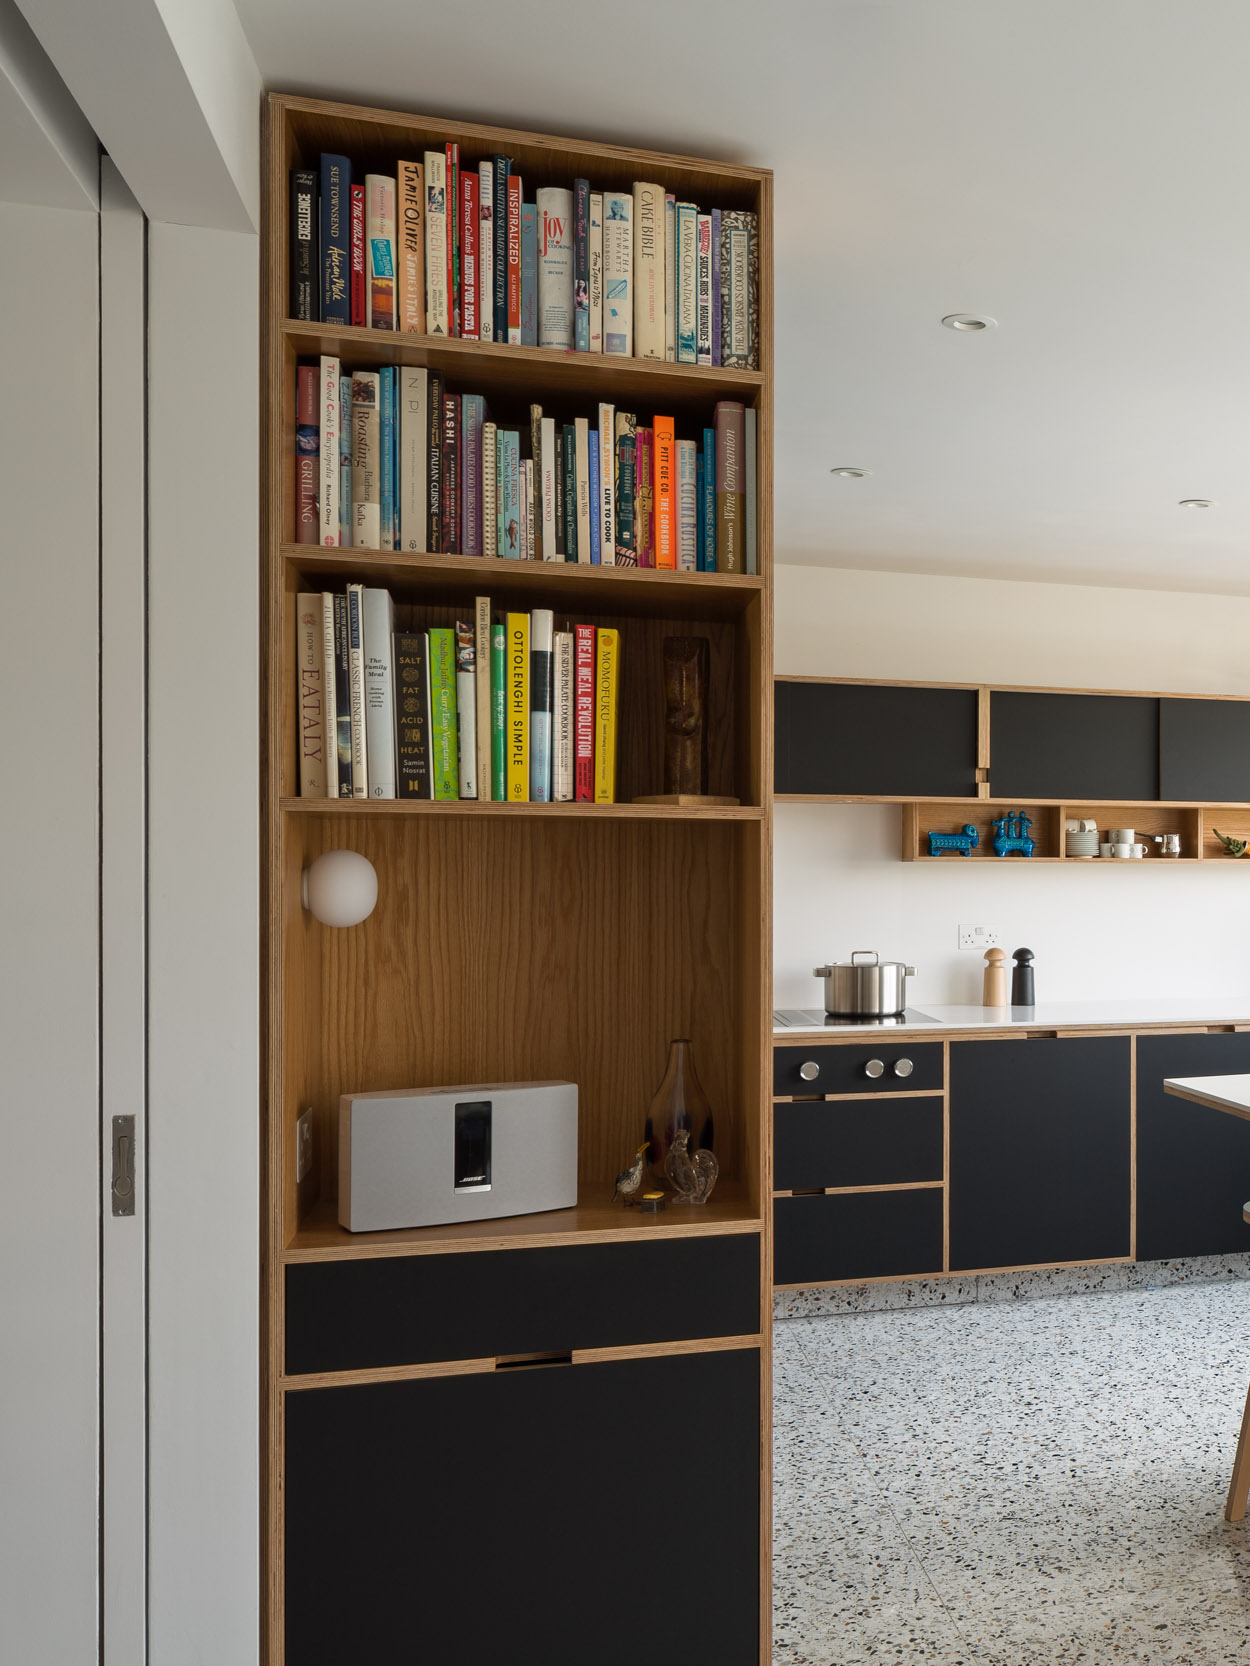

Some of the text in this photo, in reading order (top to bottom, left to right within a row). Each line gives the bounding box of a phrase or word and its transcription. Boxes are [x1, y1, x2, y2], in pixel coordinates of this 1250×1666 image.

[330, 166, 339, 237] SUE TOWNSEND
[353, 201, 362, 218] THE
[353, 219, 362, 248] GIRLS'
[496, 159, 505, 307] DELIA SMITH'S SUMMER COLLECTION
[538, 211, 568, 257] joy
[578, 218, 587, 238] Food
[641, 190, 654, 259] CAKE BIBLE
[404, 166, 420, 324] JAMIE OLIVER JAMIE'S ITALY
[430, 216, 443, 286] SEVEN FIRES
[464, 178, 474, 330] Anna Teresa Callen's MENUS FOR PASTA
[328, 246, 346, 277] Adrian
[353, 248, 363, 274] BOOK
[683, 220, 694, 325] LA VERA CUCINA ITALIANA
[734, 251, 744, 292] COOKBOOK
[331, 278, 346, 301] Mole
[699, 220, 710, 341] BARBECUE! SAUCES, RUBS MARINADES
[735, 293, 743, 318] BASICS
[735, 319, 743, 337] NEW
[327, 364, 335, 380] The
[327, 381, 335, 402] Good
[326, 403, 335, 428] Cook's
[446, 401, 455, 444] HASHI
[324, 432, 335, 478] Encyclopedia
[354, 411, 372, 526] Roasting Barbara Kafka
[660, 447, 669, 463] PITT
[723, 429, 738, 491] Companion
[467, 403, 476, 547] THE SILVER PALATE GOOD TIMES COOKBOOK
[660, 466, 669, 480] CUE
[300, 460, 312, 523] GRILLING
[580, 480, 588, 501] Patricia
[660, 483, 669, 495] CO.
[604, 507, 611, 518] TO
[661, 498, 669, 511] THE
[723, 493, 736, 520] Wine
[661, 514, 670, 554] COOKBOOK
[680, 482, 696, 564] CUCINA RUSTICA
[706, 486, 714, 562] FLAVOURS OF KOREA
[350, 592, 357, 600] LE
[579, 628, 592, 638] THE
[307, 654, 314, 665] TO
[561, 642, 569, 656] THE
[578, 640, 592, 664] REAL
[351, 652, 360, 690] CLASSIC
[439, 668, 448, 690] Jaffrey
[561, 656, 569, 679] SILVER
[578, 668, 592, 694] MEAL
[440, 689, 449, 713] Curry
[513, 631, 523, 766] OTTOLENGHI SIMPLE
[561, 680, 569, 703] PALATE
[302, 668, 322, 764] EATALY
[353, 691, 361, 727] FRENCH
[440, 713, 450, 730] Easy
[561, 704, 570, 741] COOKBOOK
[578, 697, 592, 757] REVOLUTION
[441, 732, 450, 772] Vegetarian
